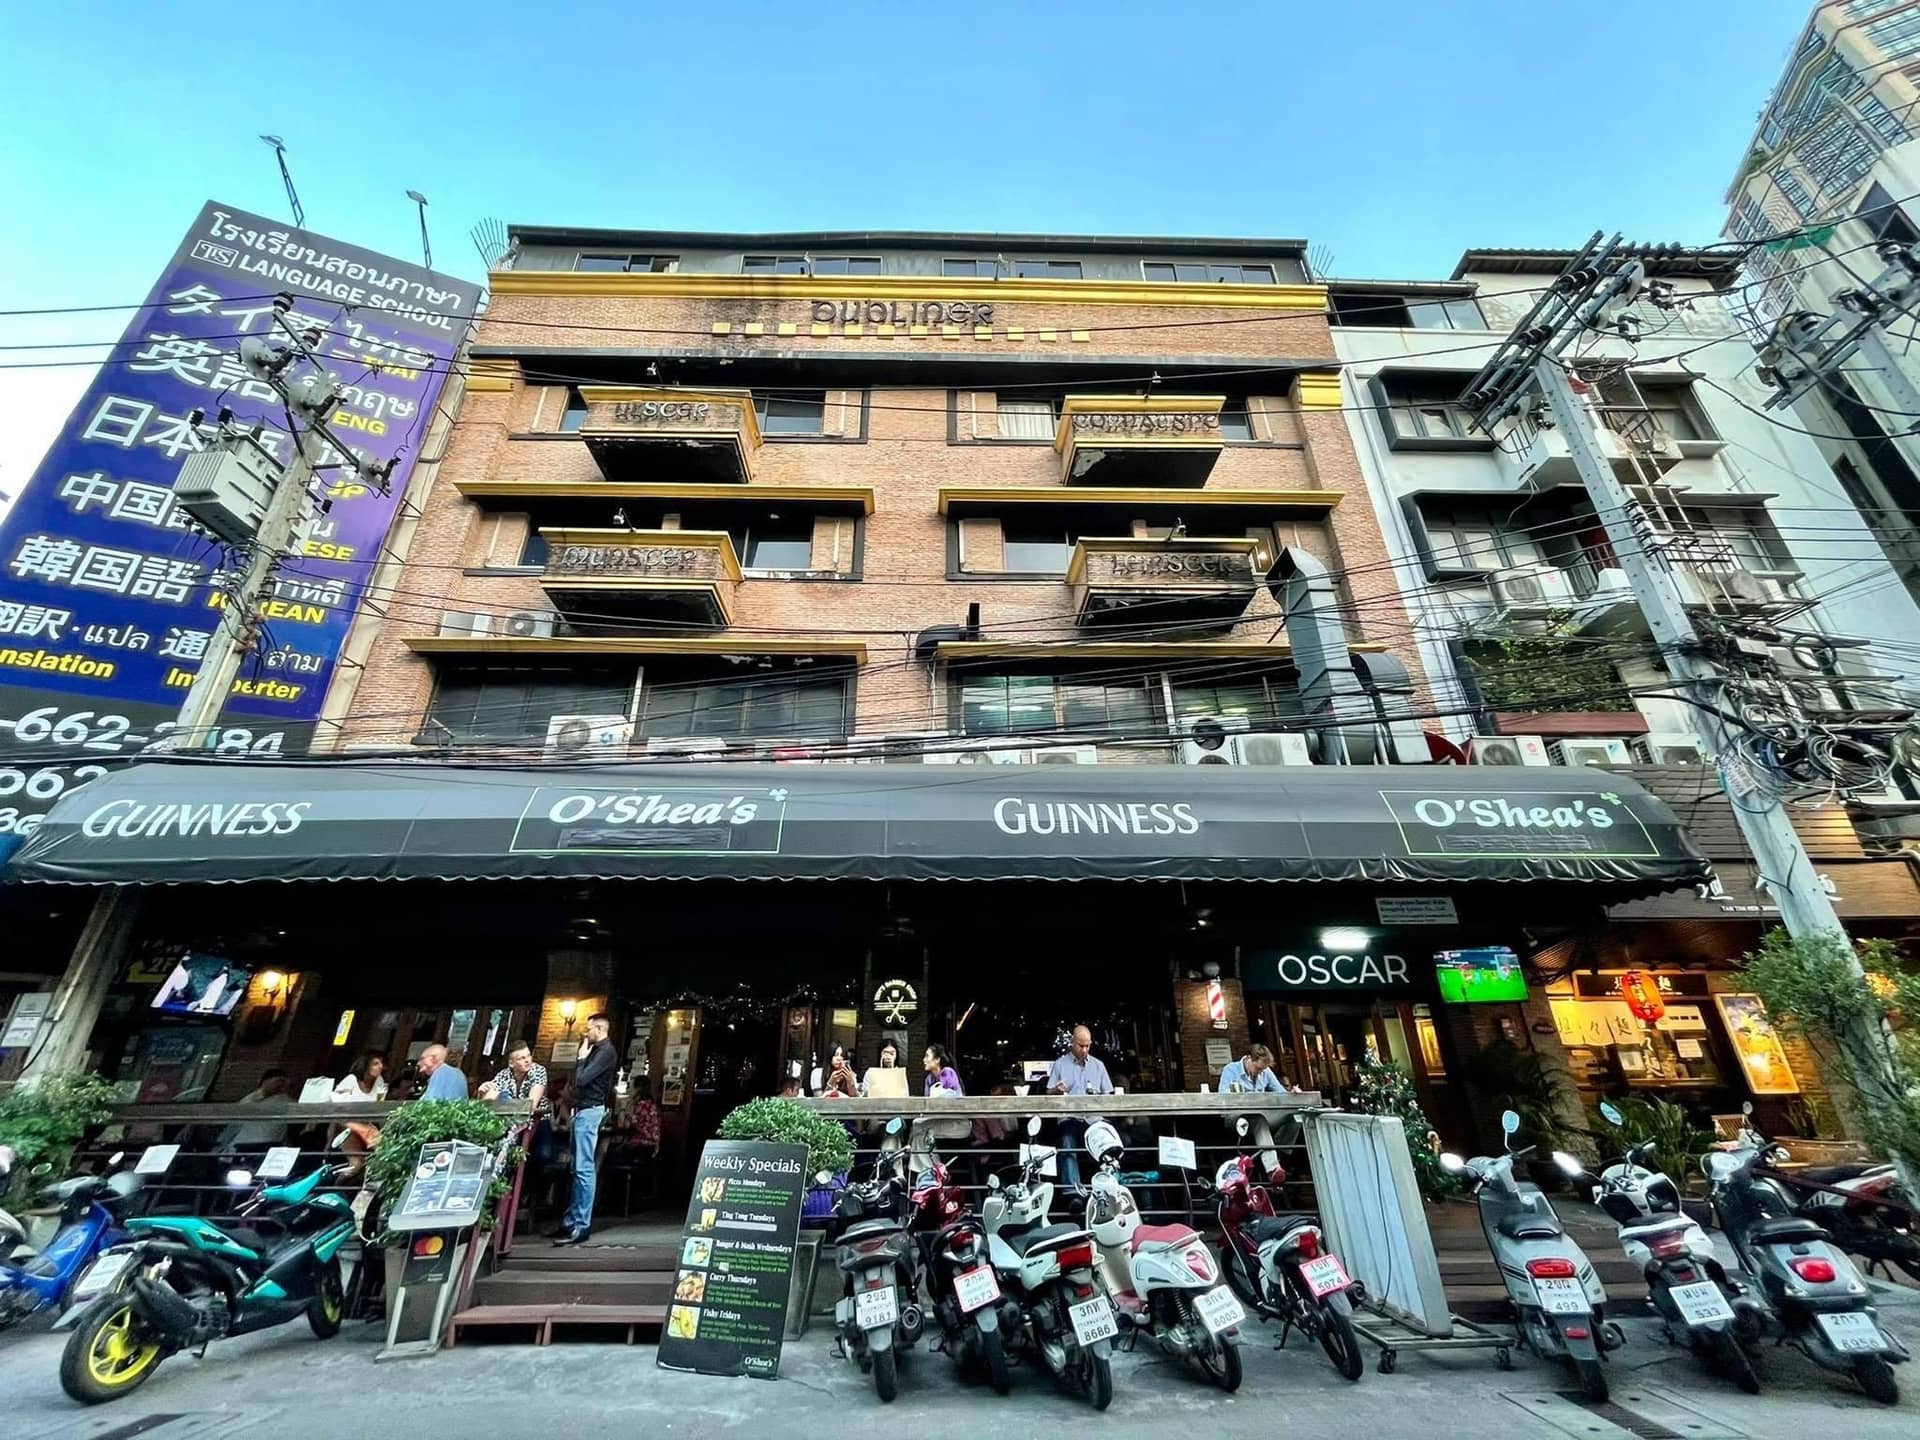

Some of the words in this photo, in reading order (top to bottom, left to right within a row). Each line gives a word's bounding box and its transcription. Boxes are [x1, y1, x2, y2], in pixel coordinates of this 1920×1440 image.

[208, 211, 462, 310] โรงเรียนสอนภาษา
[238, 255, 366, 306] LANGUAGE
[368, 295, 453, 330] SCHOOL
[332, 410, 386, 434] ENG
[328, 481, 365, 498] JP
[84, 625, 151, 652] แปล
[82, 799, 312, 838] GUINNESS
[549, 794, 758, 825] O'Shea's
[993, 797, 1199, 835] GUINNESS
[1414, 798, 1614, 829] O'Shea's
[1277, 954, 1410, 985] OSCAR
[703, 1155, 746, 1174] Weekly
[748, 1157, 801, 1174] Specials
